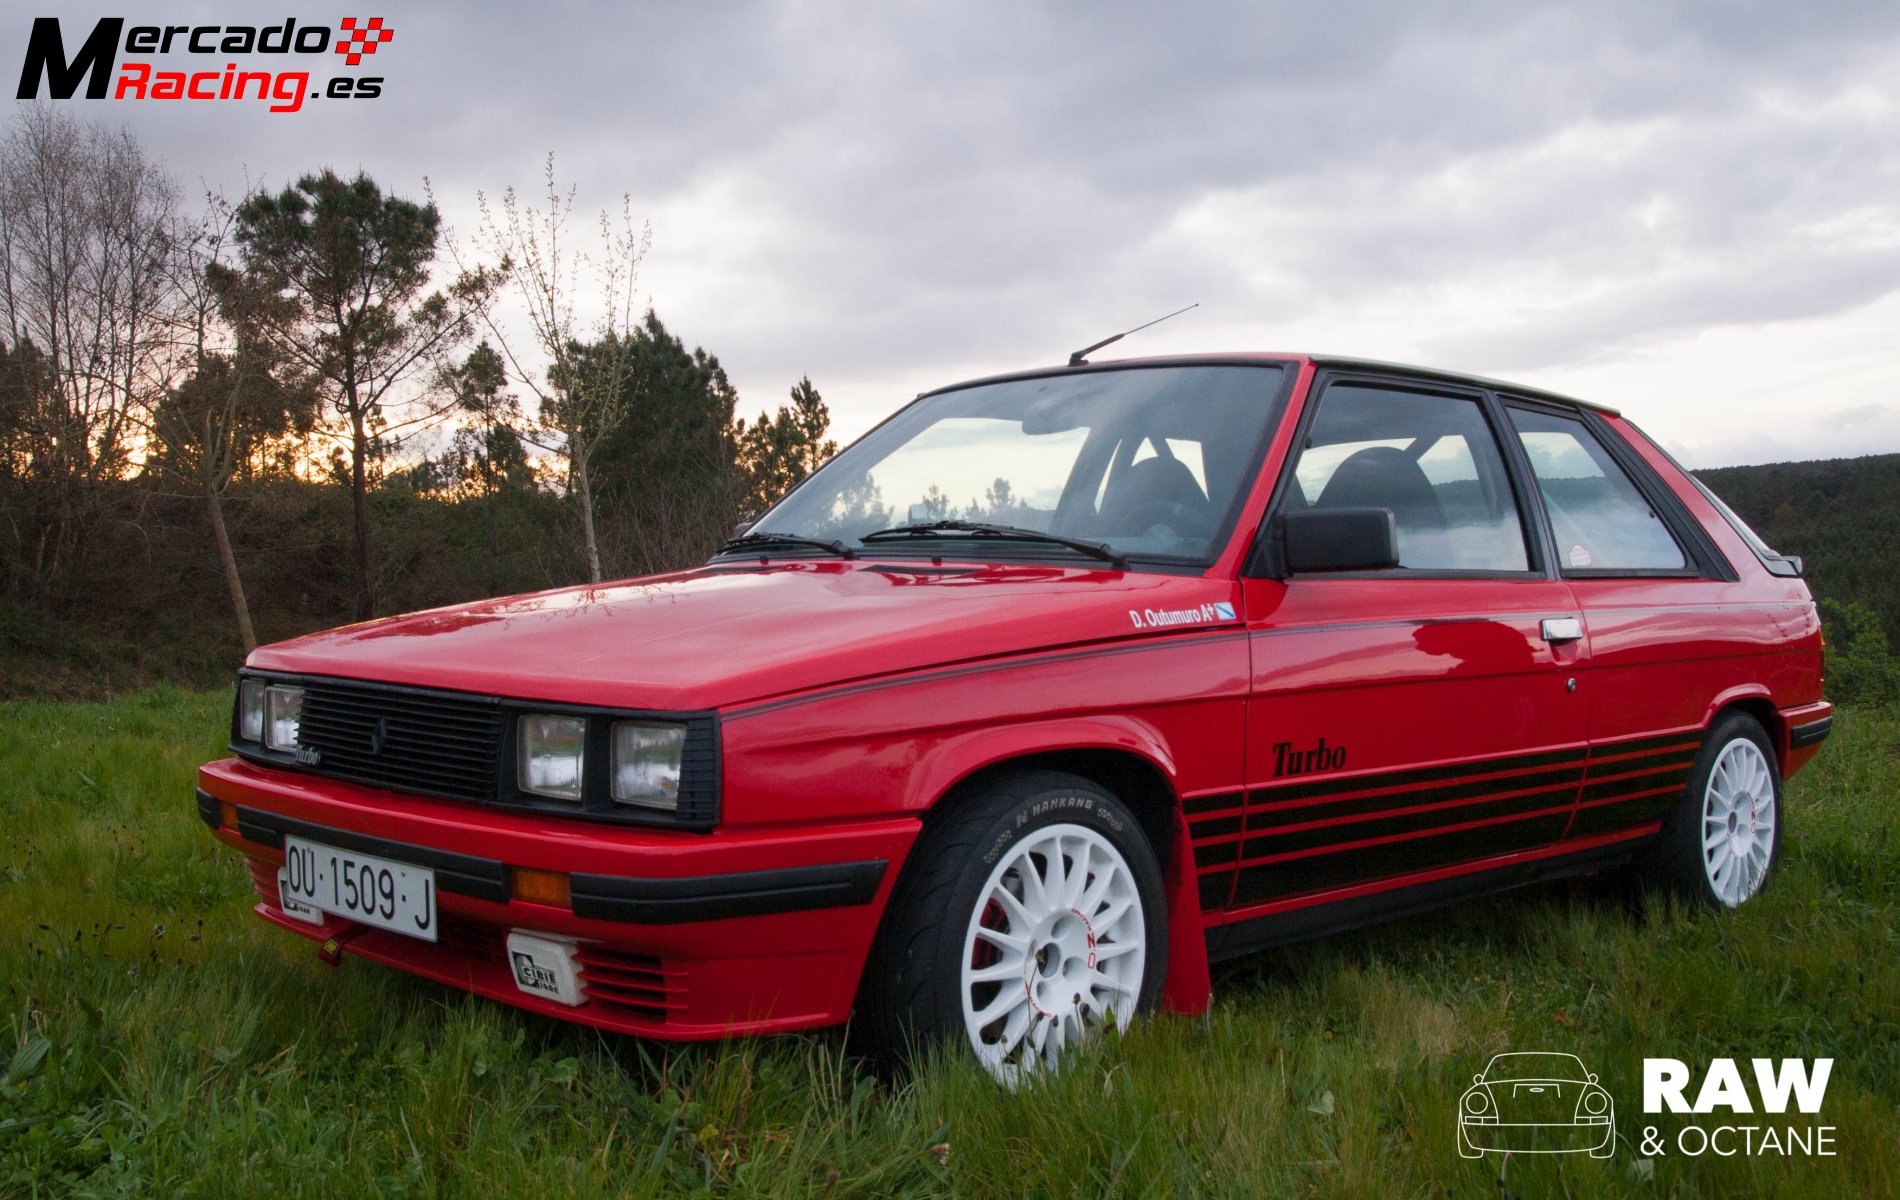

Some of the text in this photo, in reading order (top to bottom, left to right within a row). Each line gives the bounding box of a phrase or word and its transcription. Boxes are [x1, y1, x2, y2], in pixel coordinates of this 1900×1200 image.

[1129, 610, 1147, 628] D.
[1144, 608, 1201, 627] Outumuro
[296, 744, 319, 765] Turbo
[1272, 738, 1346, 777] Turbo
